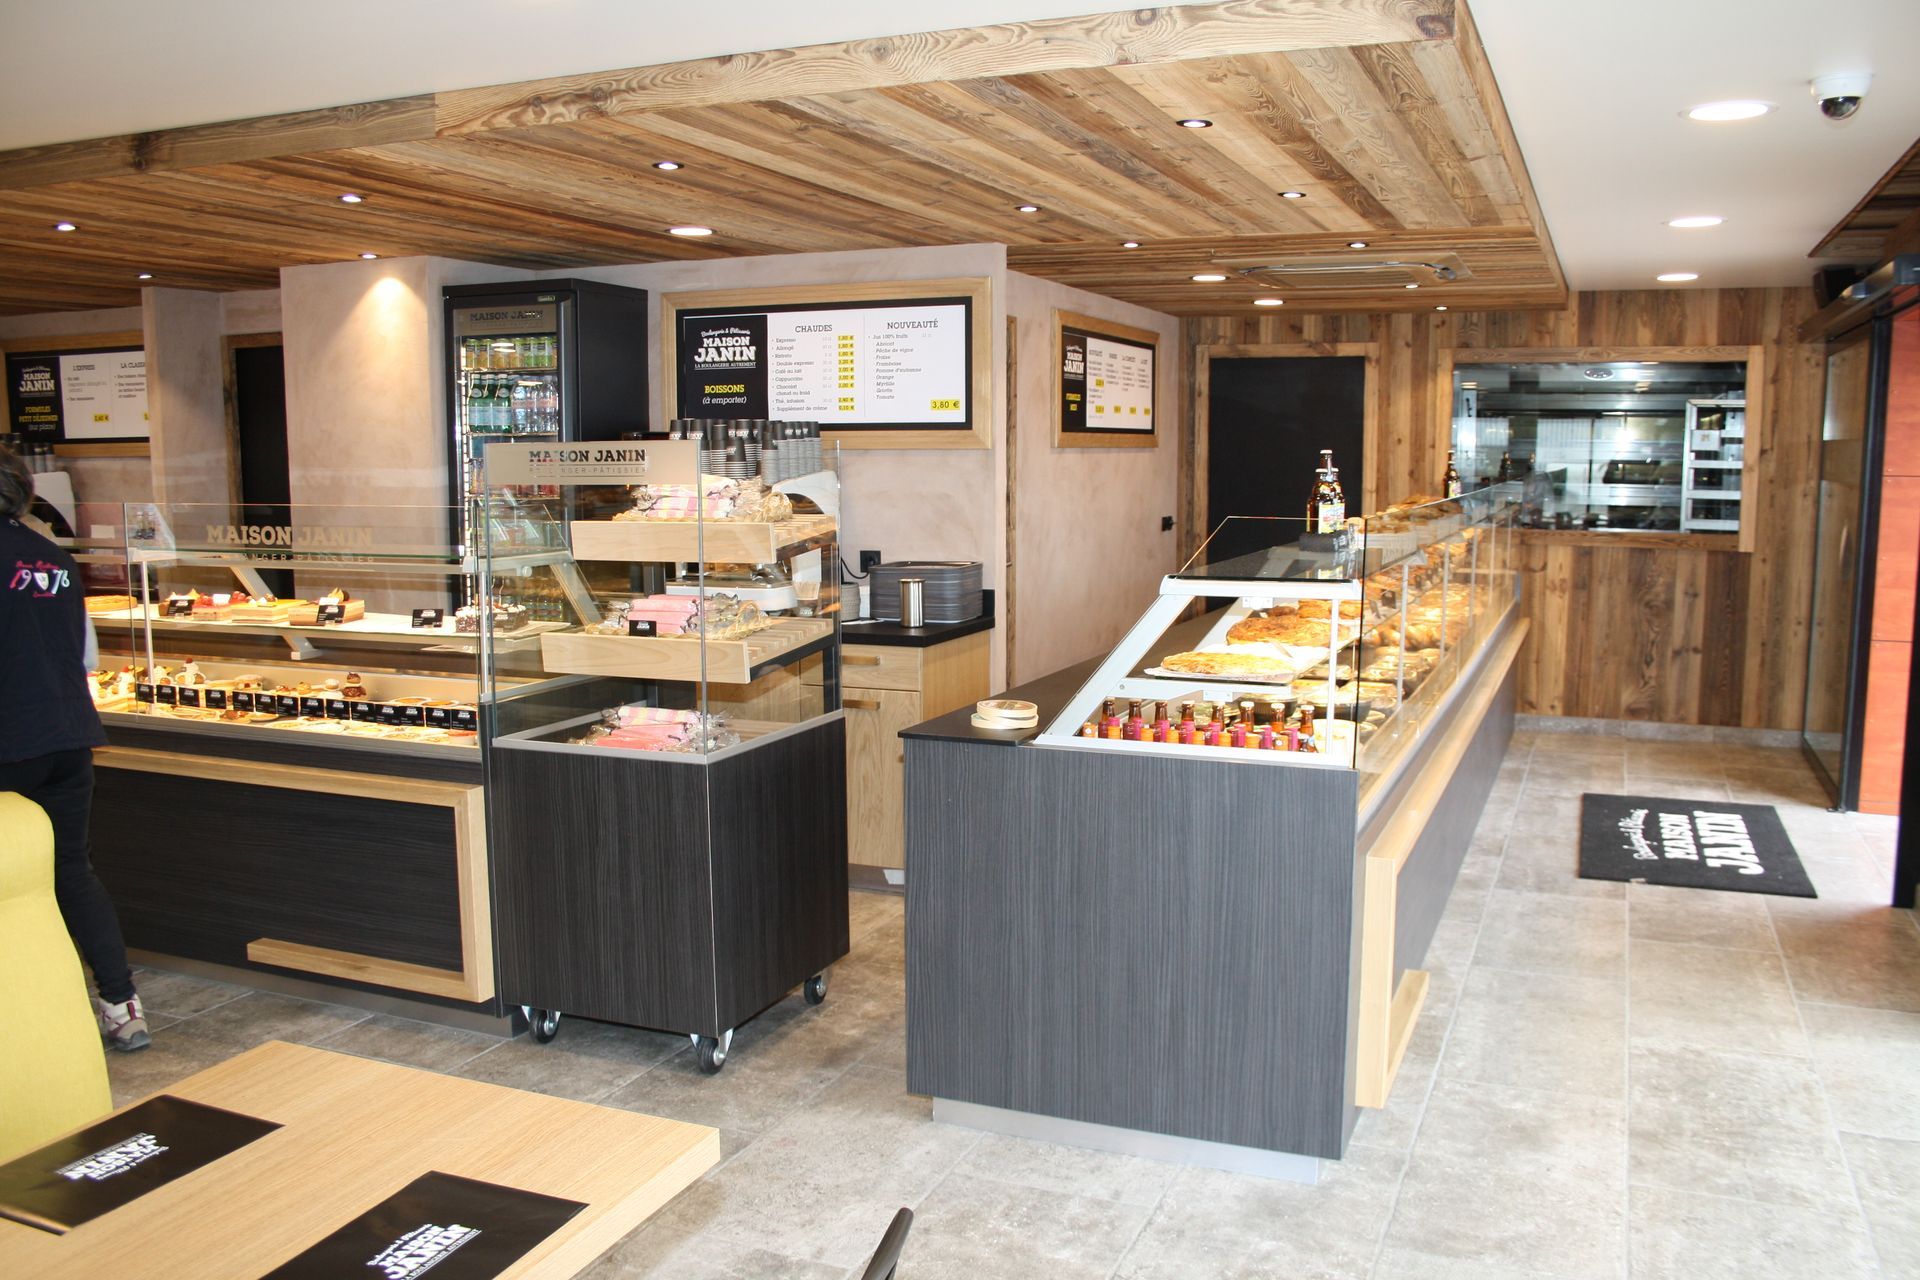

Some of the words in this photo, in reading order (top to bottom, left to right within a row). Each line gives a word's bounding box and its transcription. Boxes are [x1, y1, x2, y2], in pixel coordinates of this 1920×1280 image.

[795, 324, 833, 333] CHAUDES
[887, 318, 939, 329] NOUVEAUTÉ
[703, 337, 751, 347] MAISON
[694, 346, 756, 362] JANIN
[23, 372, 51, 381] MAISON
[19, 380, 56, 392] JANIN
[704, 384, 745, 394] BOISSONS
[702, 397, 711, 405] (à
[711, 396, 747, 405] emporter)
[953, 400, 960, 409] €
[594, 449, 646, 462] JANIN
[206, 525, 292, 546] MAISON
[299, 526, 373, 546] JANIN
[1658, 812, 1699, 861] MAISON
[1693, 810, 1765, 875] JANIN
[63, 1135, 158, 1181] JANIN
[377, 1226, 445, 1268] MAISON
[383, 1222, 472, 1280] JANIN
